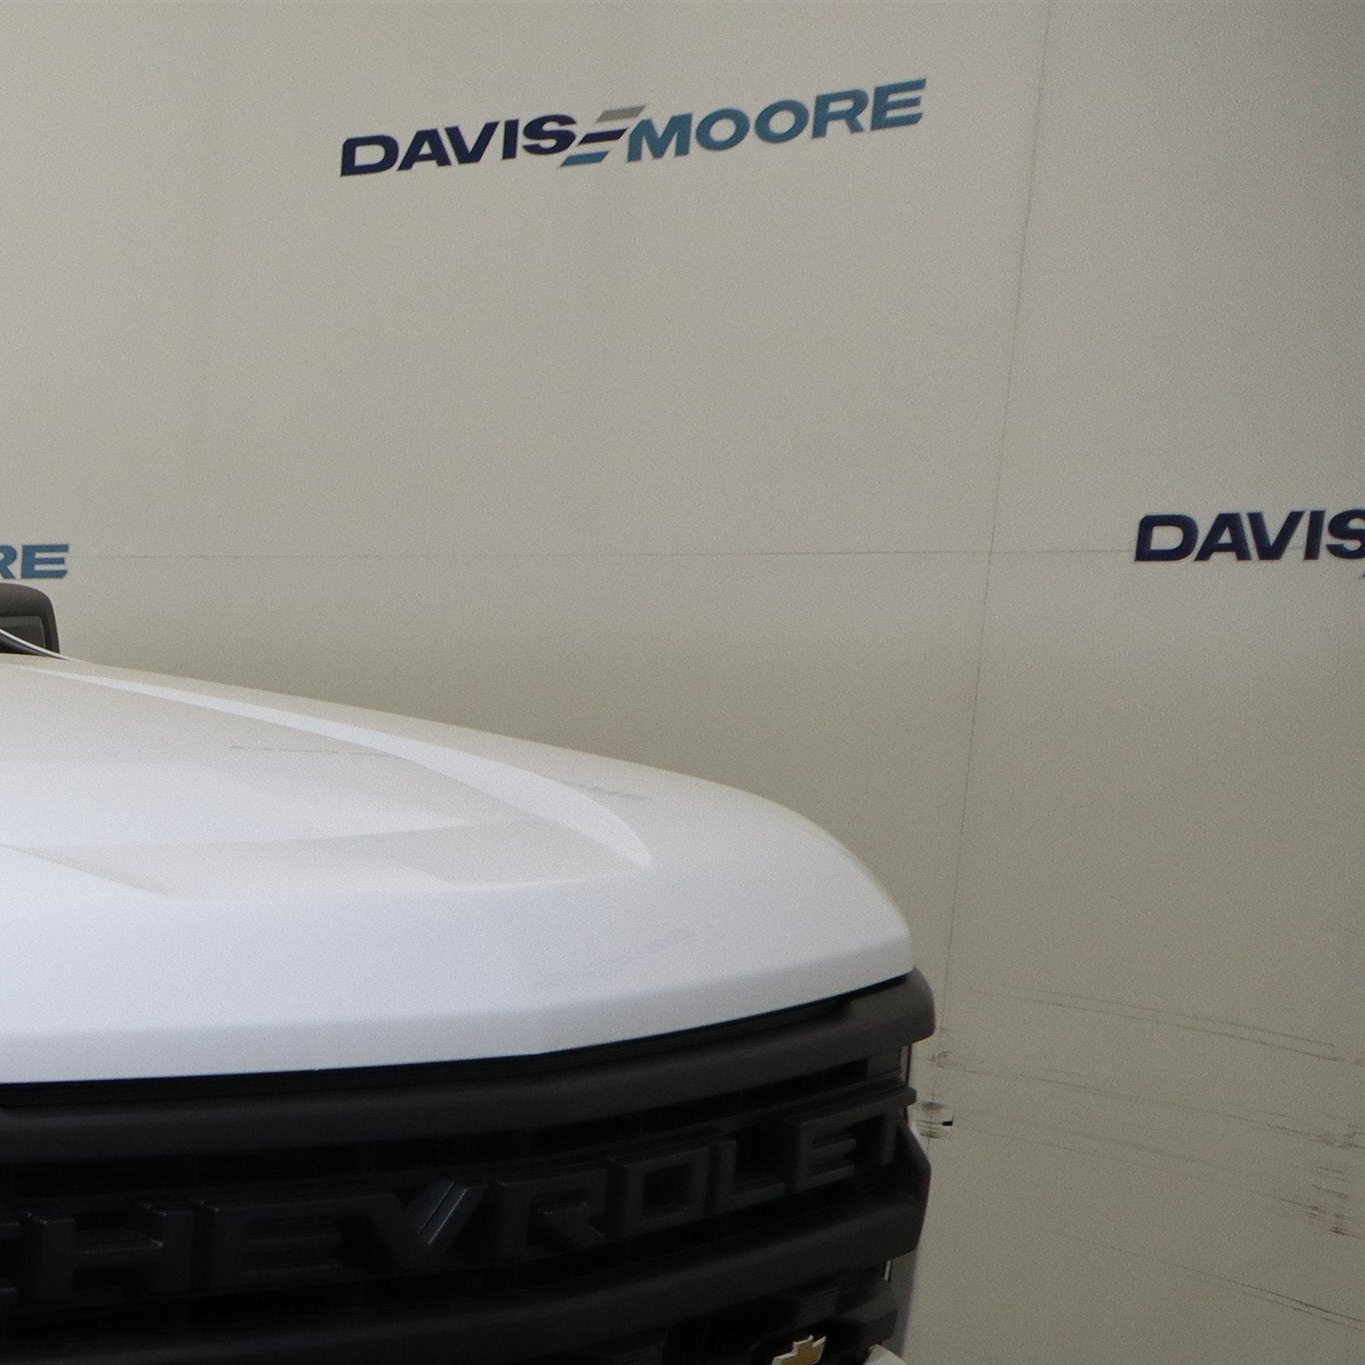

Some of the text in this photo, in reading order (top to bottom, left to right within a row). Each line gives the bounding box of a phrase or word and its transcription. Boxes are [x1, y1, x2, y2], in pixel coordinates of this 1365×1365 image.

[339, 78, 927, 177] DAVIS MOORE
[1134, 508, 1365, 562] DAVIS
